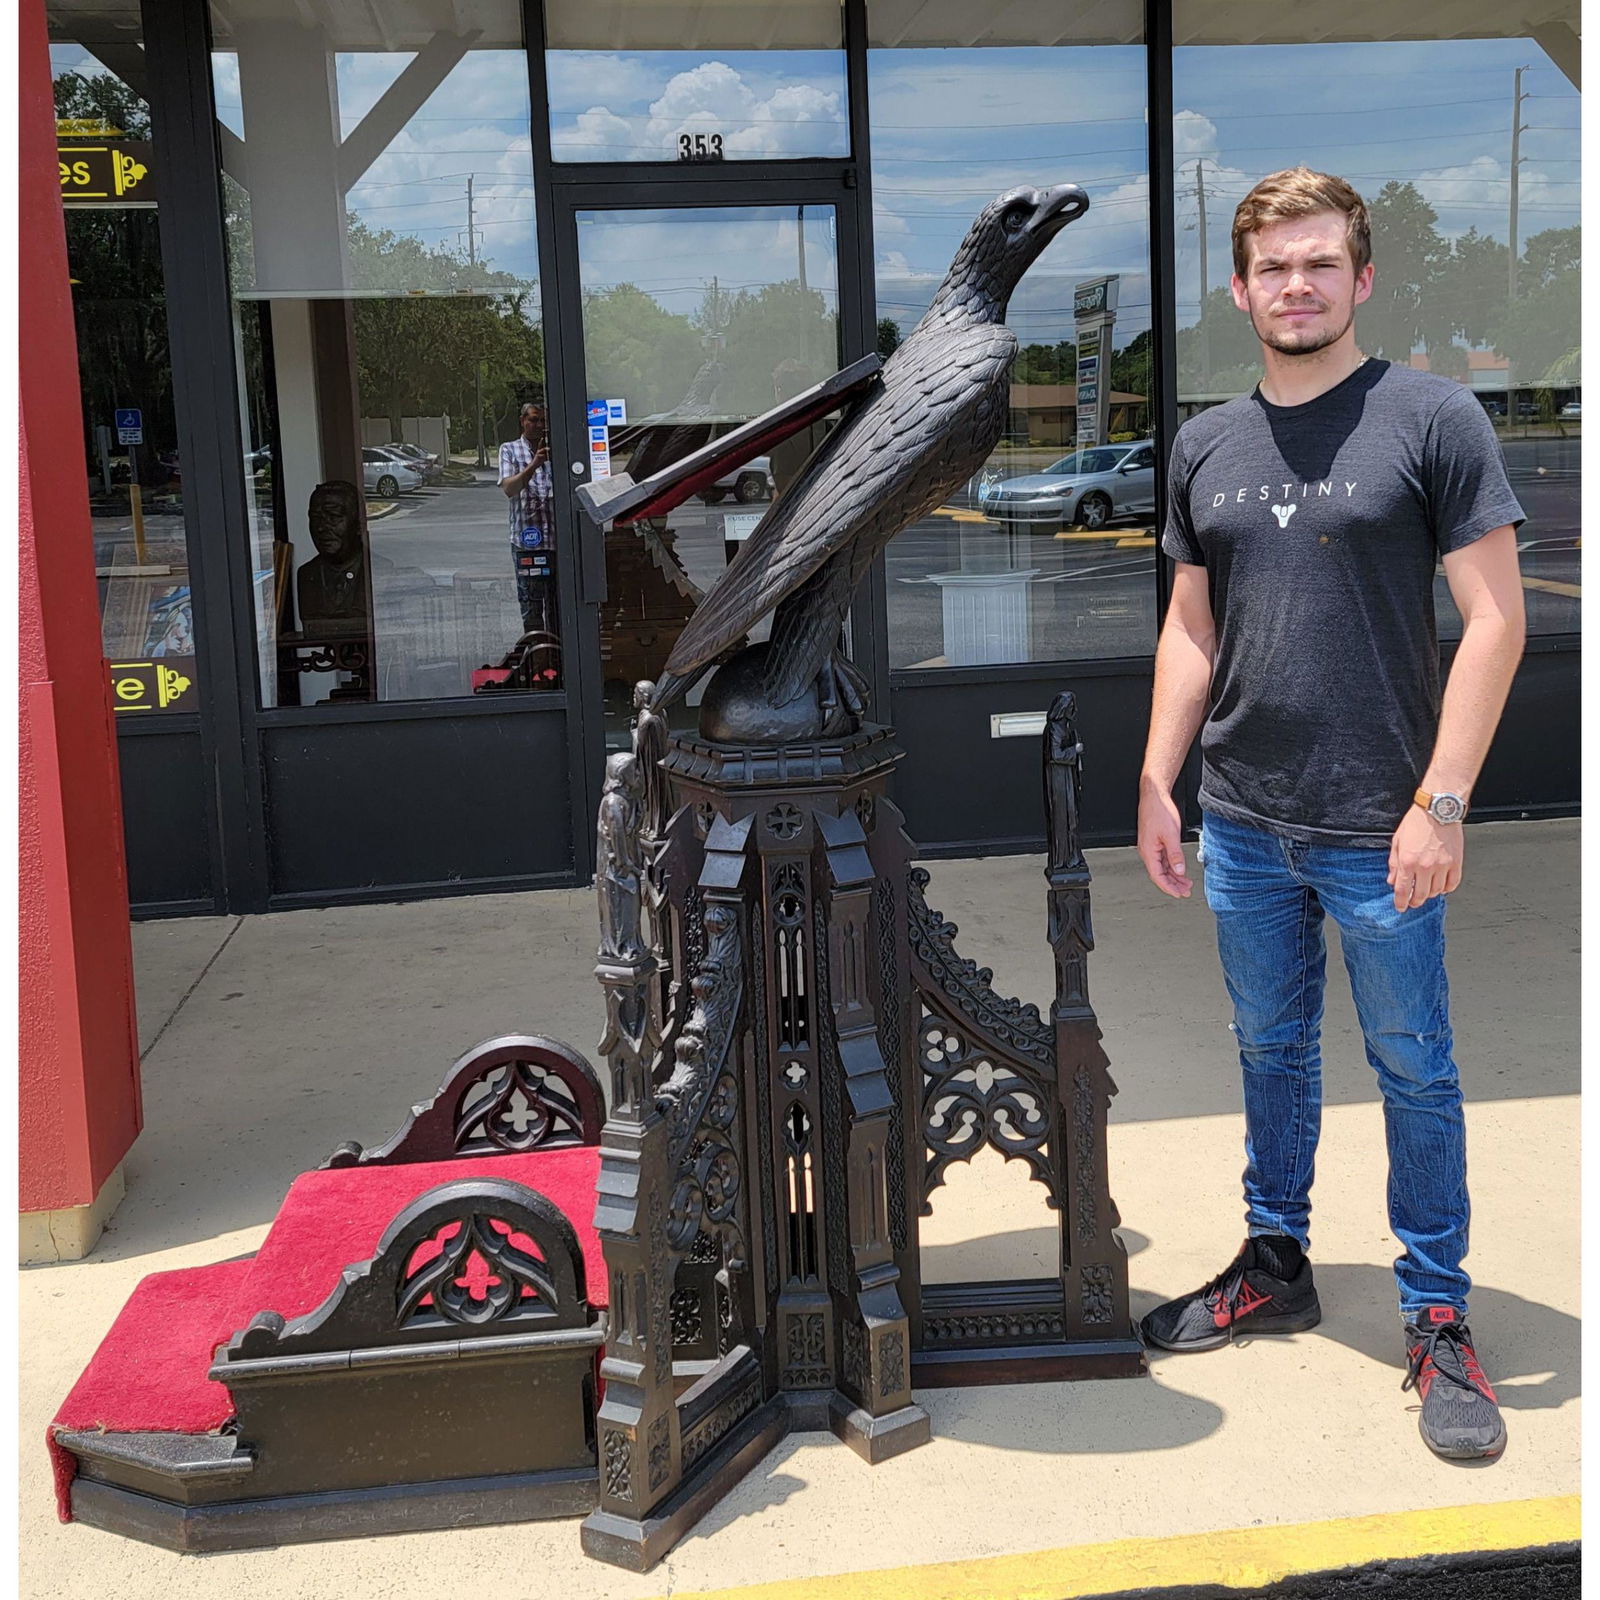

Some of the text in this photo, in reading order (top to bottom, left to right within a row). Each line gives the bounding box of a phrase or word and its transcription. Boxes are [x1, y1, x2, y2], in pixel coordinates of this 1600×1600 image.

[679, 133, 723, 160] 353
[1212, 481, 1357, 508] DESTINY
[523, 531, 539, 541] ADT
[1433, 1310, 1451, 1320] NIKE
